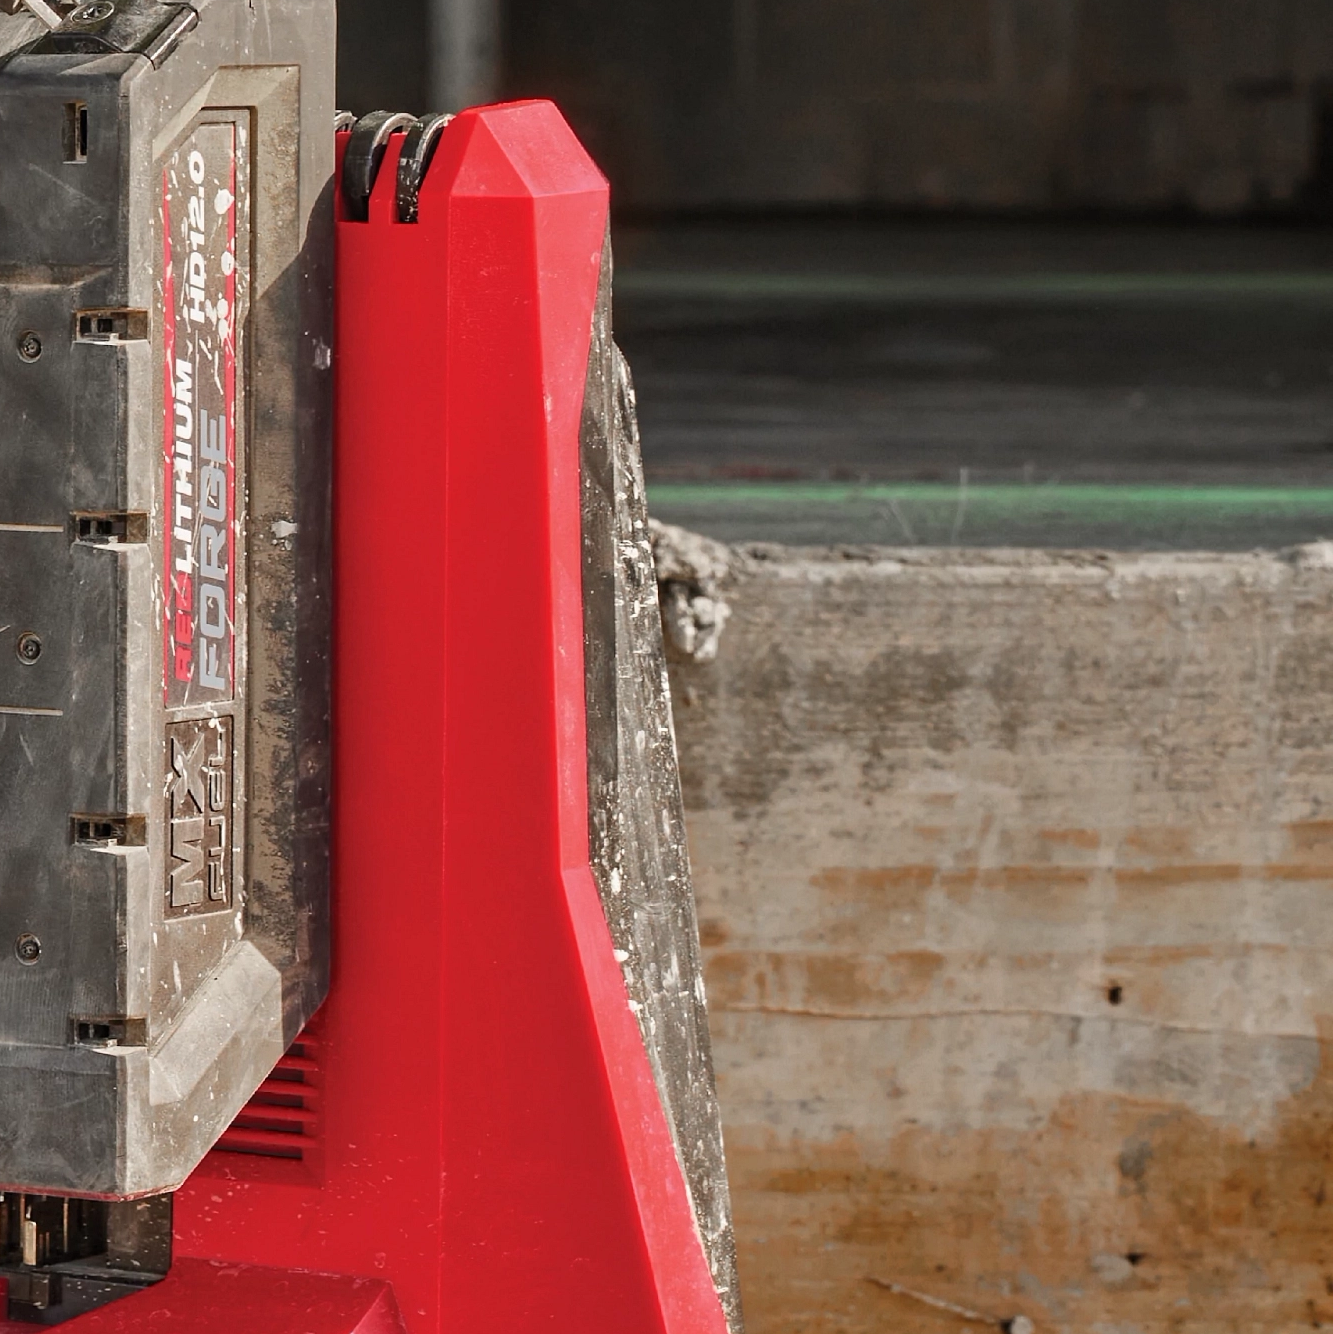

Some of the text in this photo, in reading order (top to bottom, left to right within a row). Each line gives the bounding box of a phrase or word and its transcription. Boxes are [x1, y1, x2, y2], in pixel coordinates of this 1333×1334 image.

[184, 150, 206, 324] HD12.0
[199, 409, 227, 691] FORGE
[170, 732, 206, 908] MX
